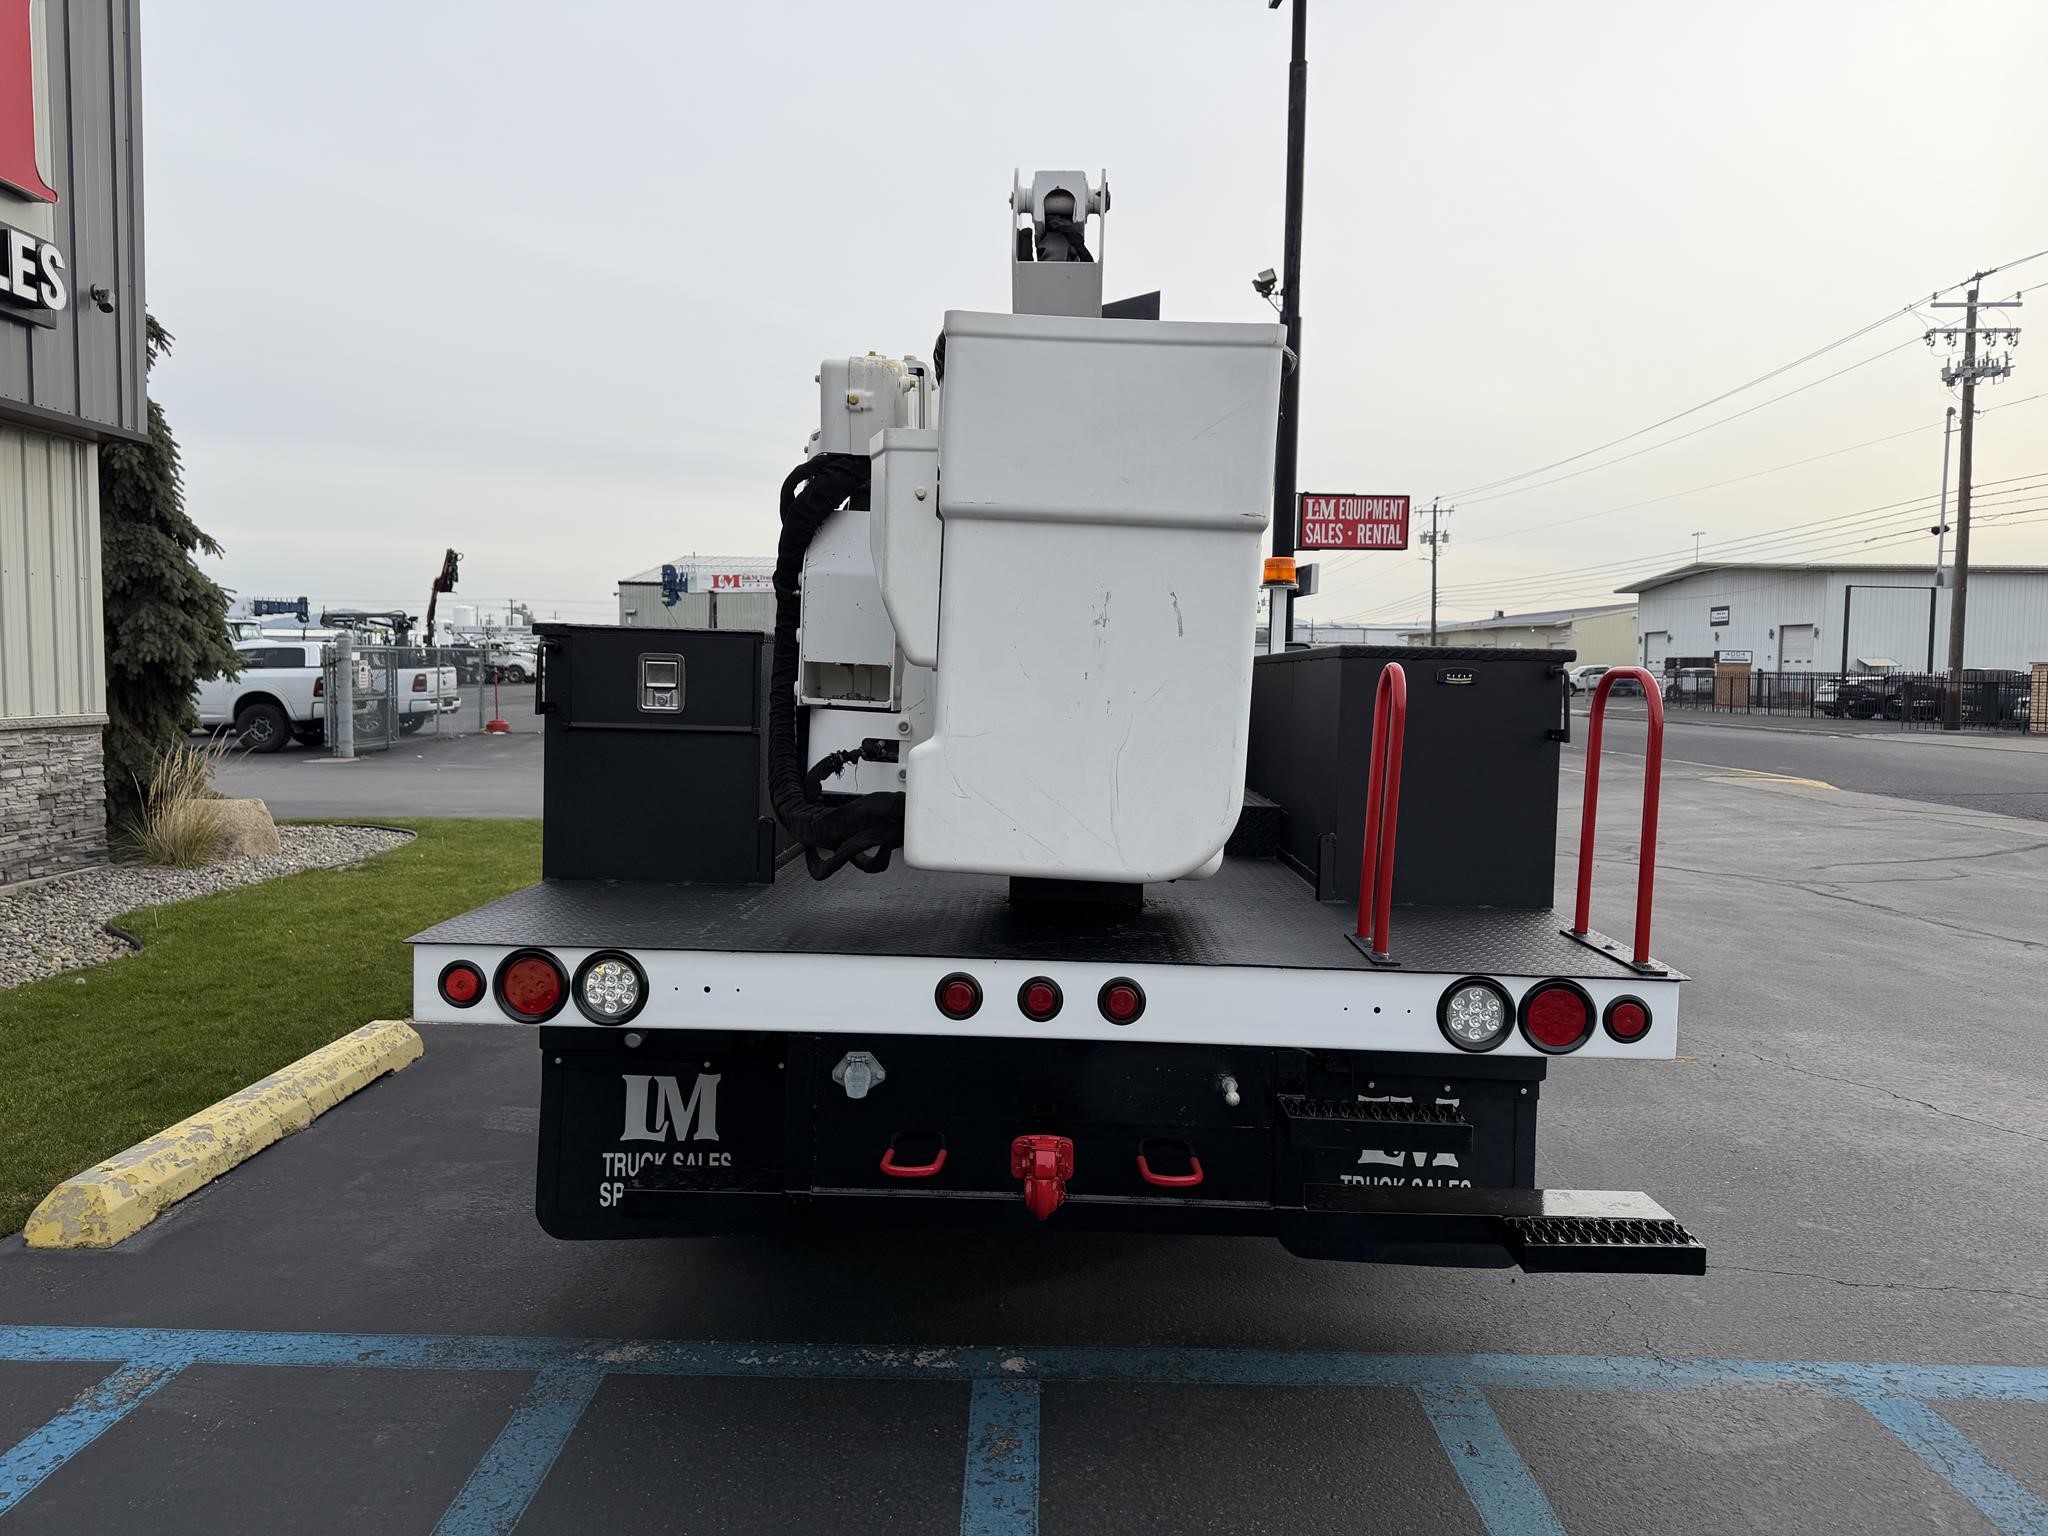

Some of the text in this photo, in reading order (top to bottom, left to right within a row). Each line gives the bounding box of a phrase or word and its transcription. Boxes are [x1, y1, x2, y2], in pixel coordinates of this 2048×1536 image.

[1339, 499, 1405, 520] EQUIPMENT
[1305, 523, 1403, 545] SALES RENTAL
